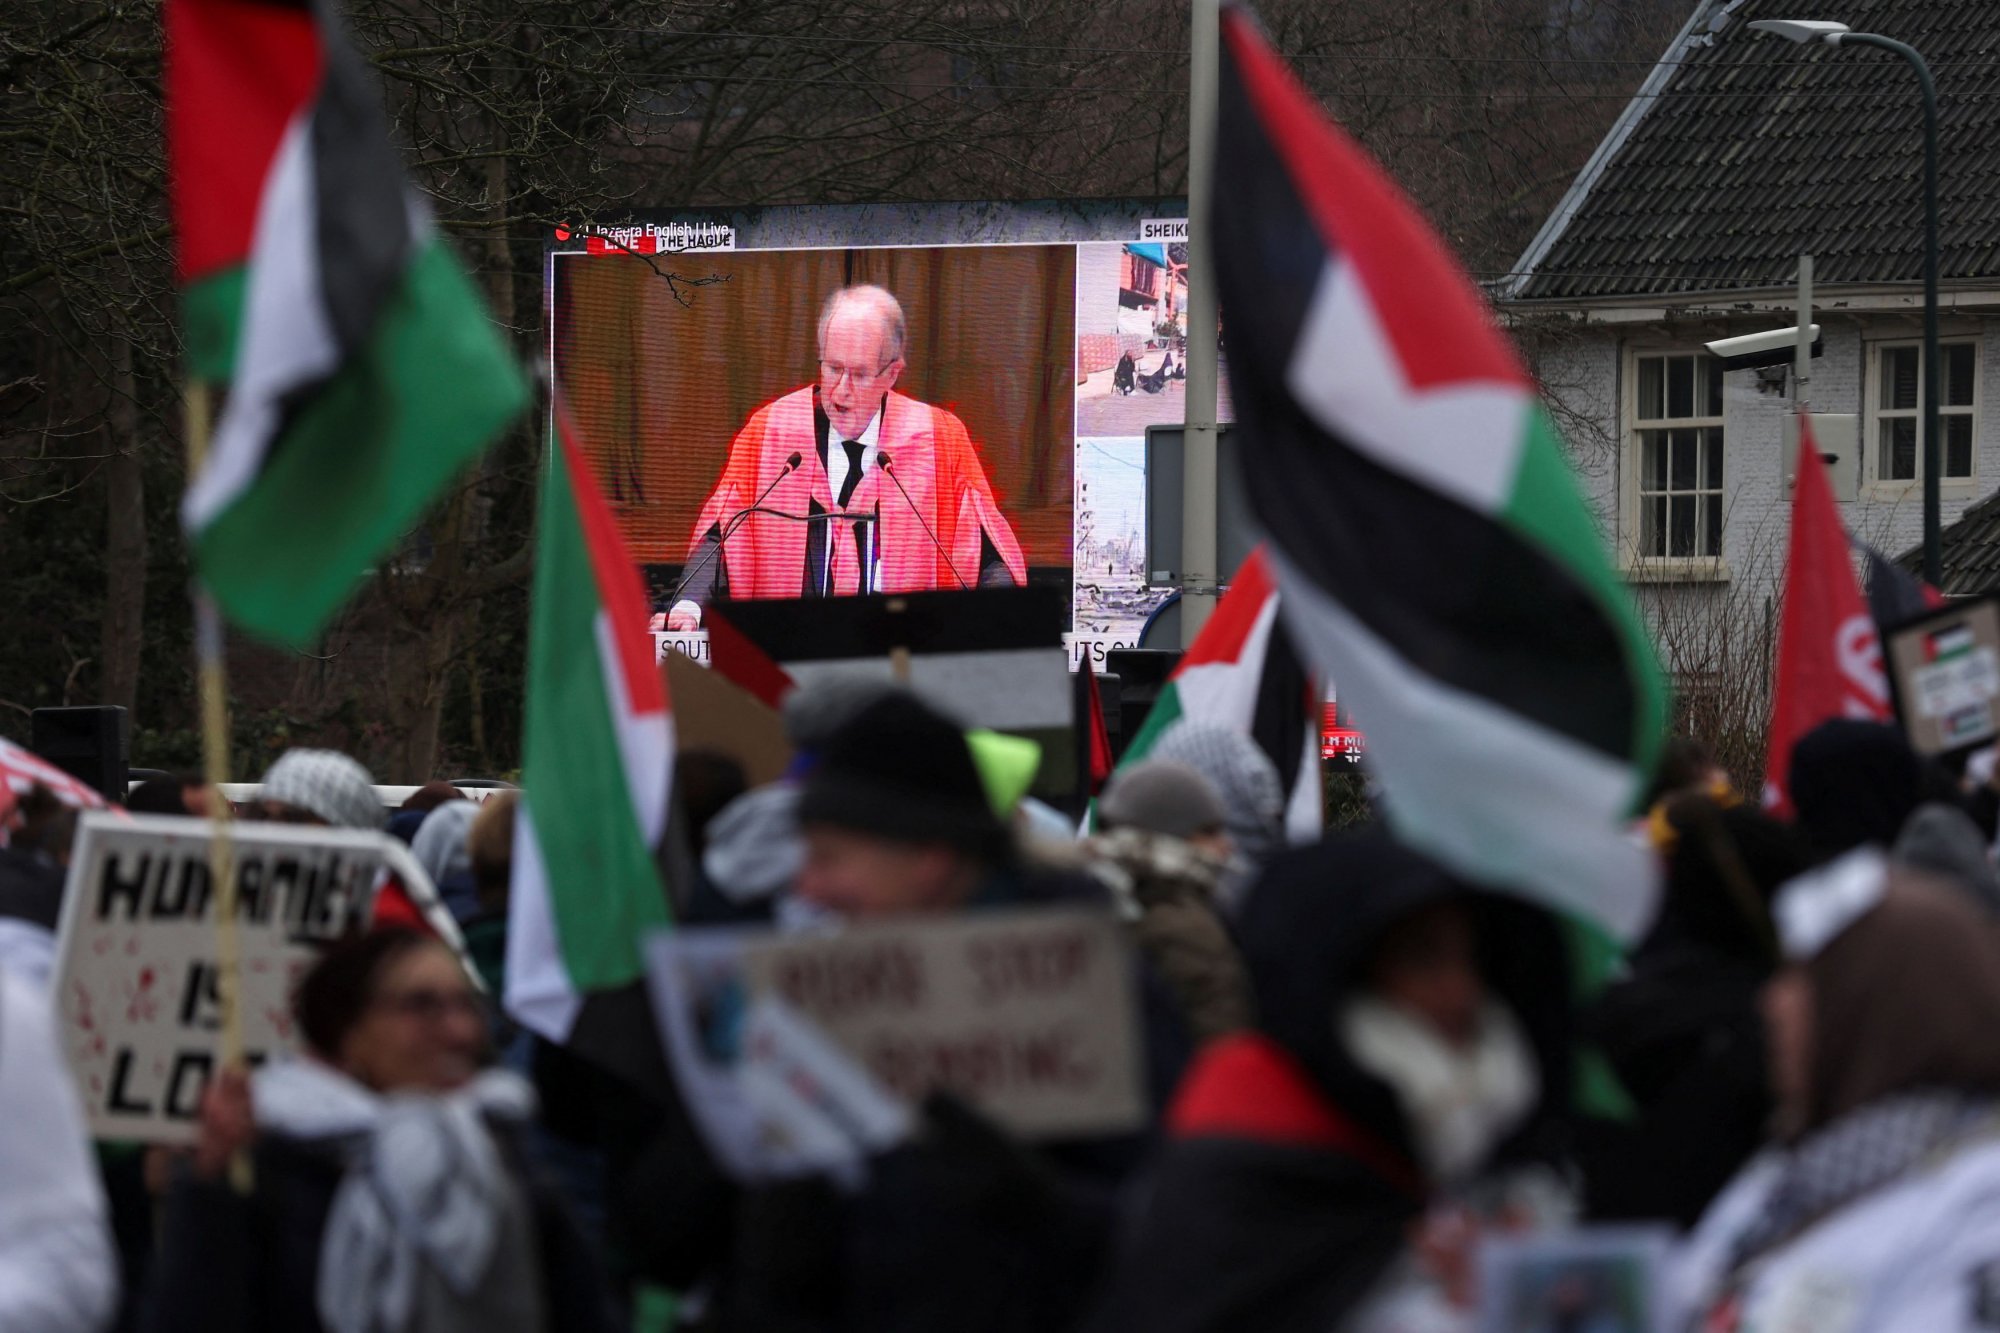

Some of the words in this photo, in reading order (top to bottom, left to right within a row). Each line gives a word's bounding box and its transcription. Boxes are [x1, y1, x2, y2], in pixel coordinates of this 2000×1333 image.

[646, 222, 692, 240] English
[703, 222, 729, 236] Live
[661, 234, 684, 248] THE
[688, 234, 731, 248] HAGUE
